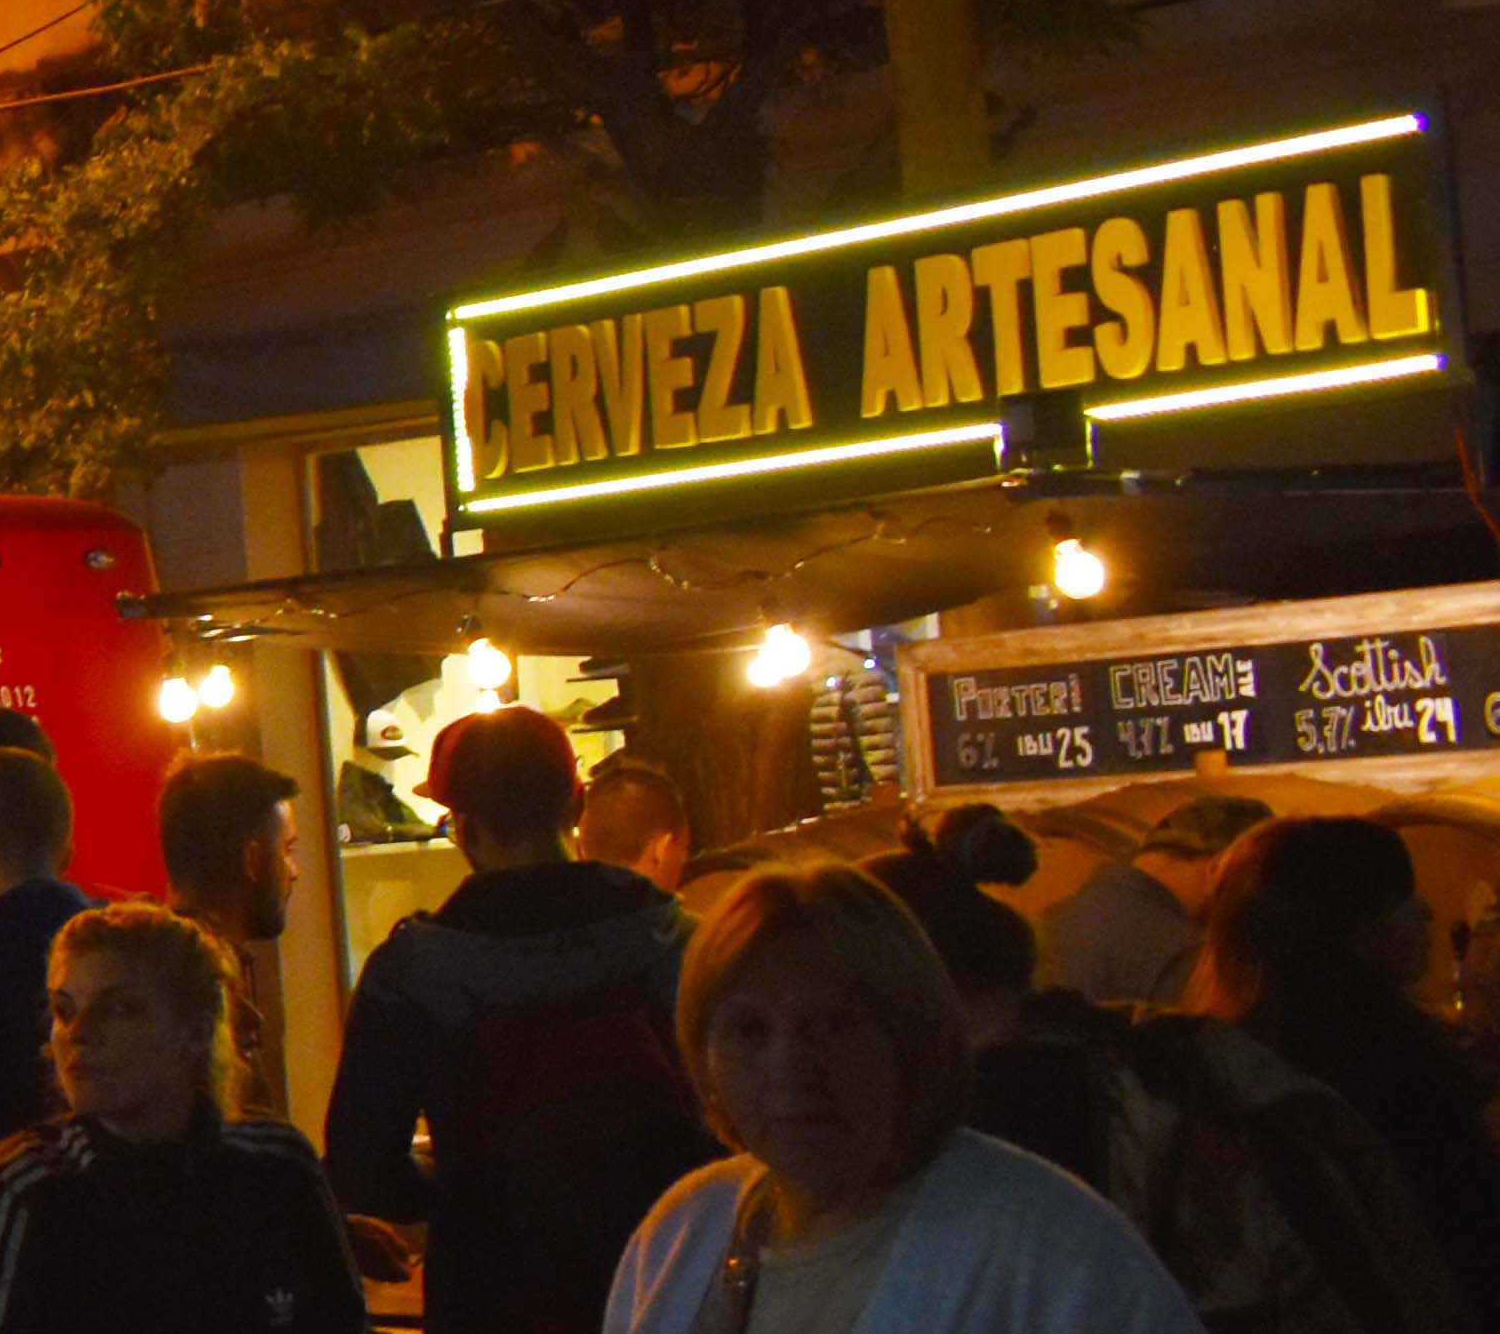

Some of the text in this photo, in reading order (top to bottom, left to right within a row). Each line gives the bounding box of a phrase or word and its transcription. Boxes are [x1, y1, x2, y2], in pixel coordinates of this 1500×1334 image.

[467, 172, 1430, 480] CERVEZA ARTESANAL
[1109, 652, 1235, 710] CREAM
[1299, 635, 1446, 699] Scottish
[1056, 725, 1094, 768] 25
[1217, 709, 1249, 751] 17
[1415, 697, 1458, 744] 24
